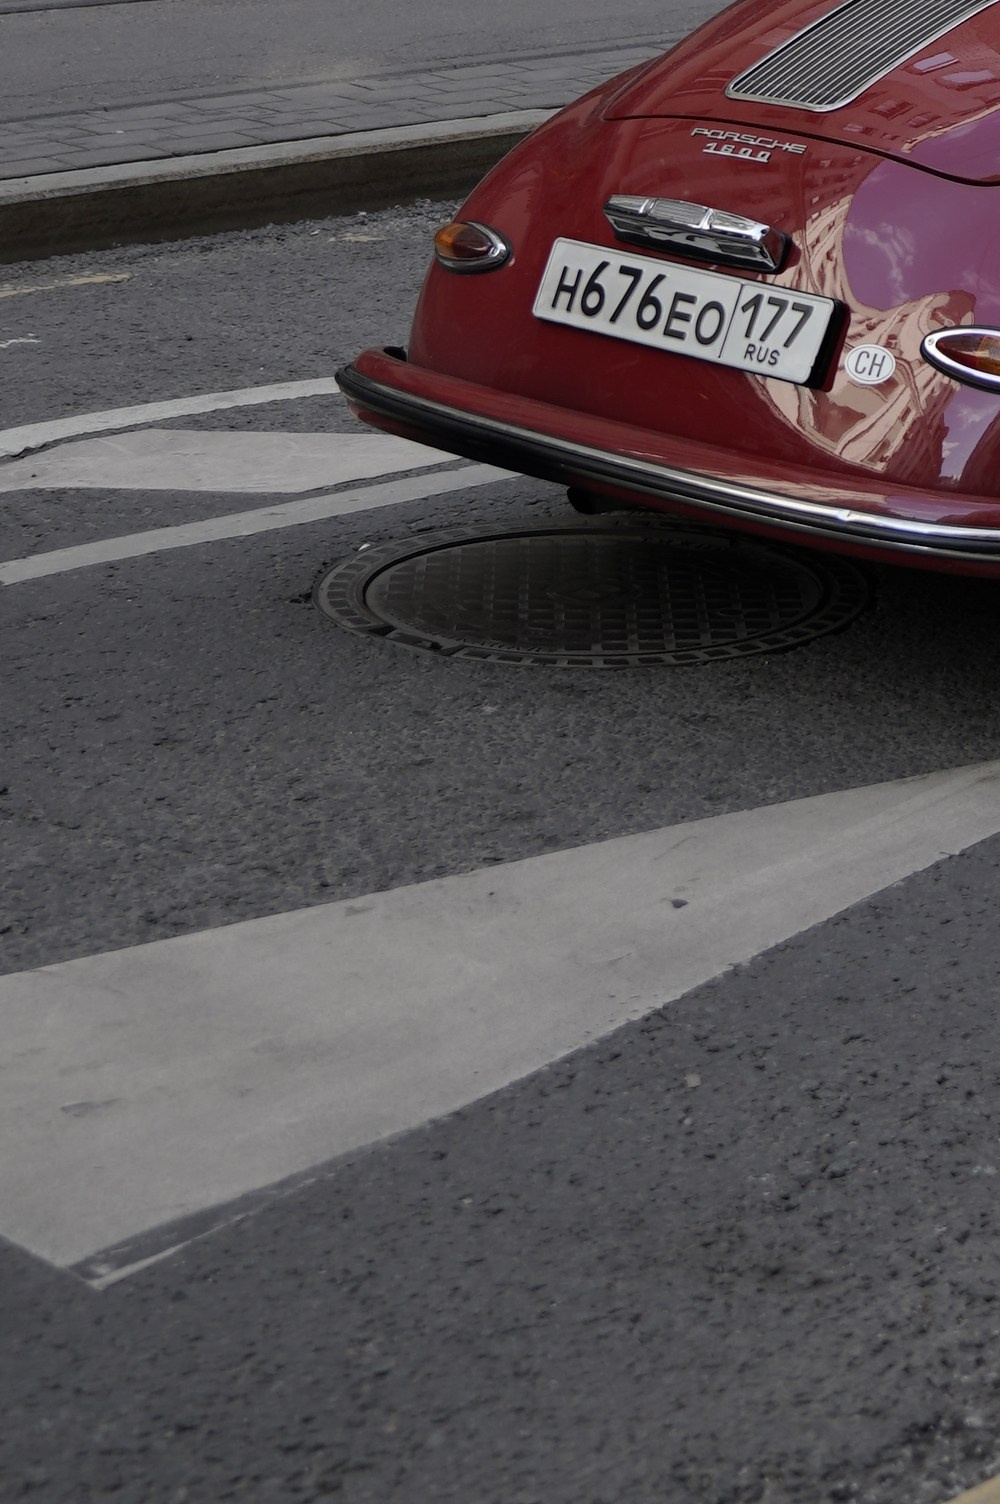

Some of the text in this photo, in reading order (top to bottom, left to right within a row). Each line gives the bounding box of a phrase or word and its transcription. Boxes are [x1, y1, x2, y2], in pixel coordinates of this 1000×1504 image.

[690, 127, 808, 155] PORSCHE
[703, 142, 772, 163] 1600
[743, 343, 781, 367] RUS
[853, 350, 885, 378] CH
